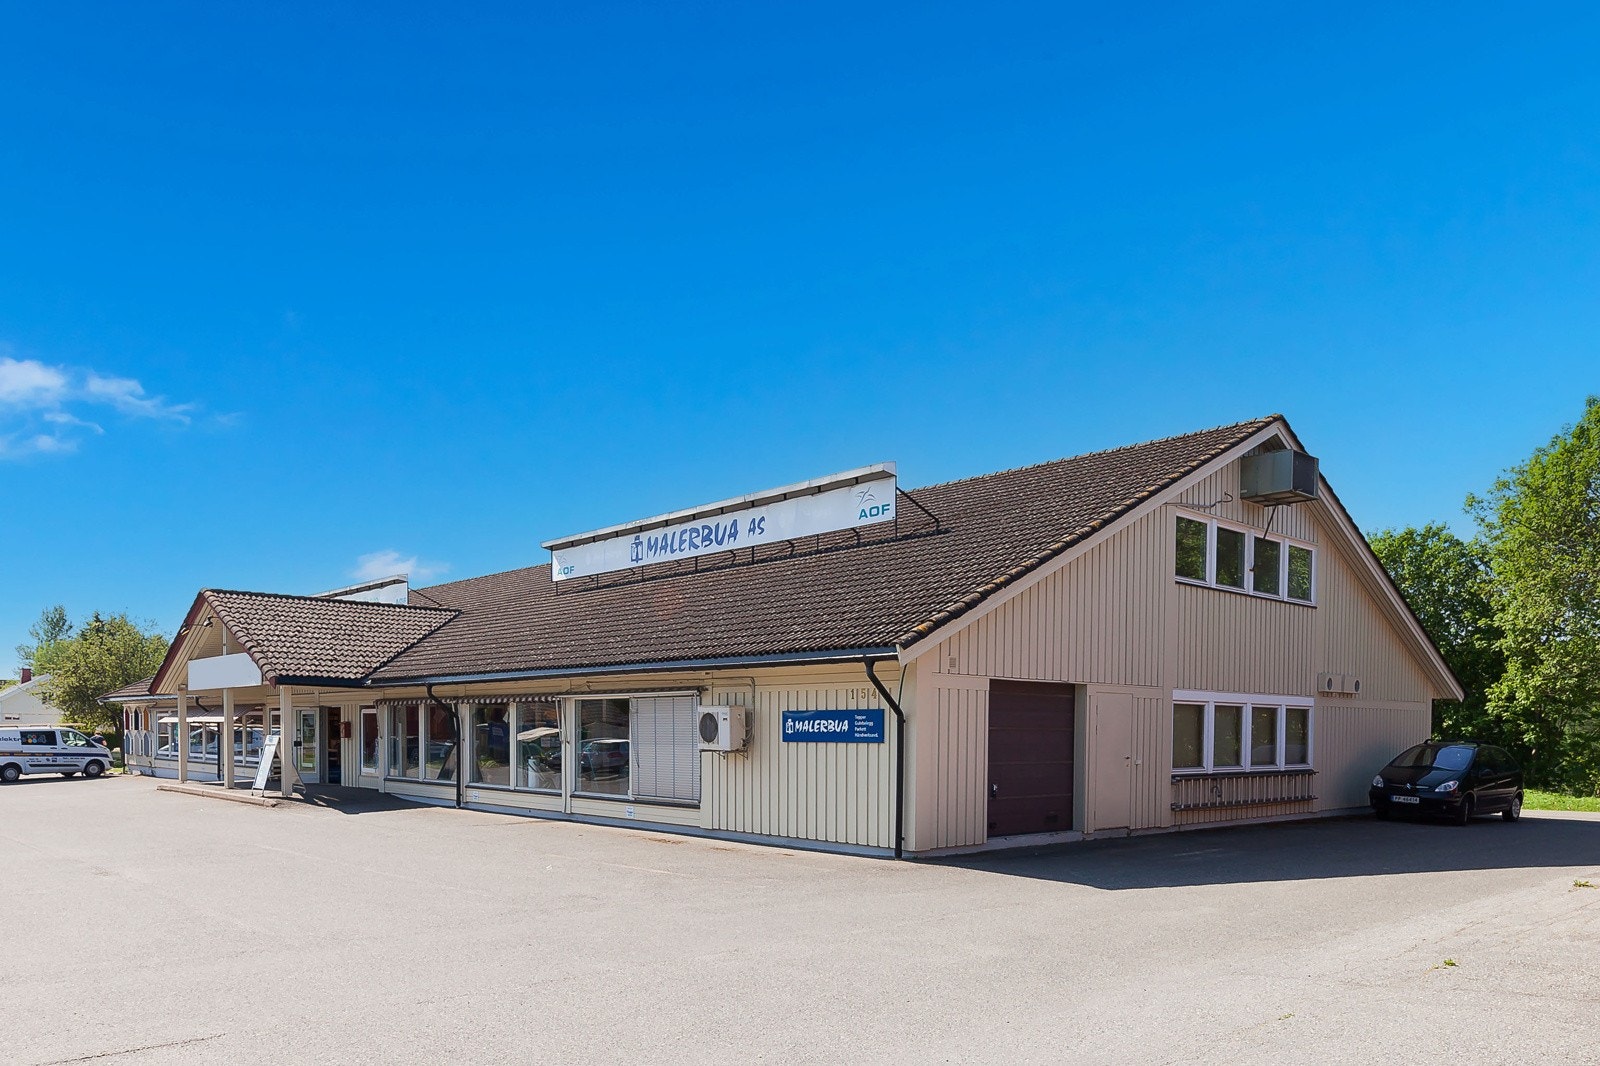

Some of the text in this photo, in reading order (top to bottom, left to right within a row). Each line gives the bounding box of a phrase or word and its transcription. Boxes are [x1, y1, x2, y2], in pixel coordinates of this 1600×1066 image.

[859, 503, 891, 520] AOF
[646, 515, 766, 558] MALERBUA AS
[557, 566, 575, 576] AOF
[795, 719, 849, 732] MALERBUA
